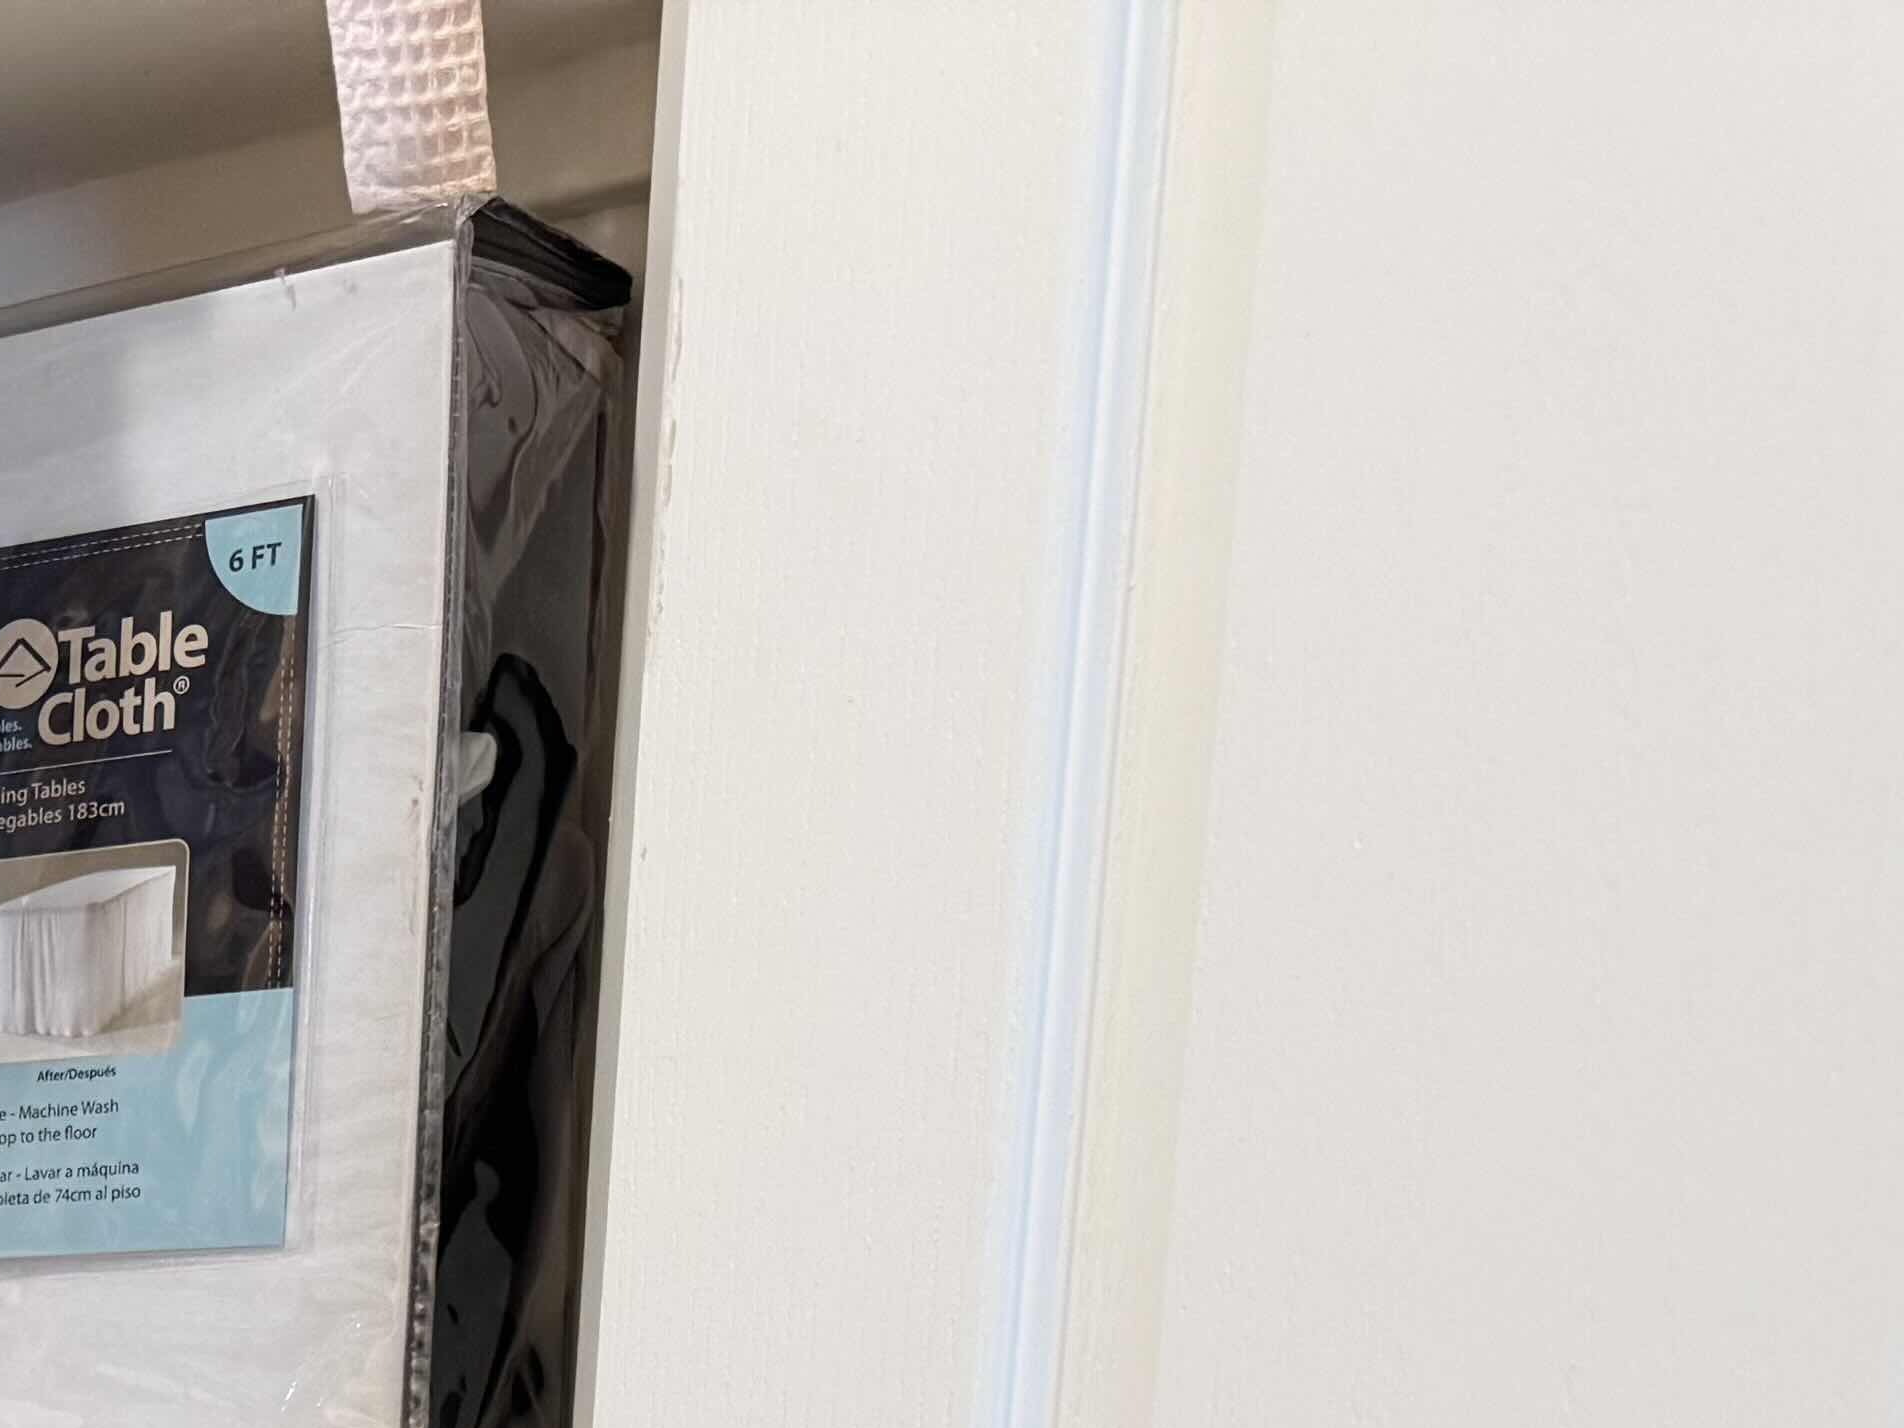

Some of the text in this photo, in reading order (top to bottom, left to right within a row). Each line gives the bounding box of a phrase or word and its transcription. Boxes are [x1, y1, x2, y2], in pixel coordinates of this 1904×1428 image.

[229, 542, 281, 572] 6 FT
[58, 610, 209, 684] Table
[32, 778, 86, 800] Tables
[68, 800, 125, 822] 183cm
[18, 1103, 78, 1120] Machine
[81, 1098, 119, 1115] Wash
[20, 1130, 34, 1144] to
[38, 1127, 61, 1142] the
[64, 1124, 98, 1140] floor
[24, 1166, 62, 1181] Lavar
[65, 1168, 73, 1178] a
[76, 1160, 140, 1180] máquina
[33, 1189, 51, 1204] de
[55, 1188, 92, 1203] 74cm
[95, 1185, 108, 1200] al
[111, 1185, 142, 1202] piso
